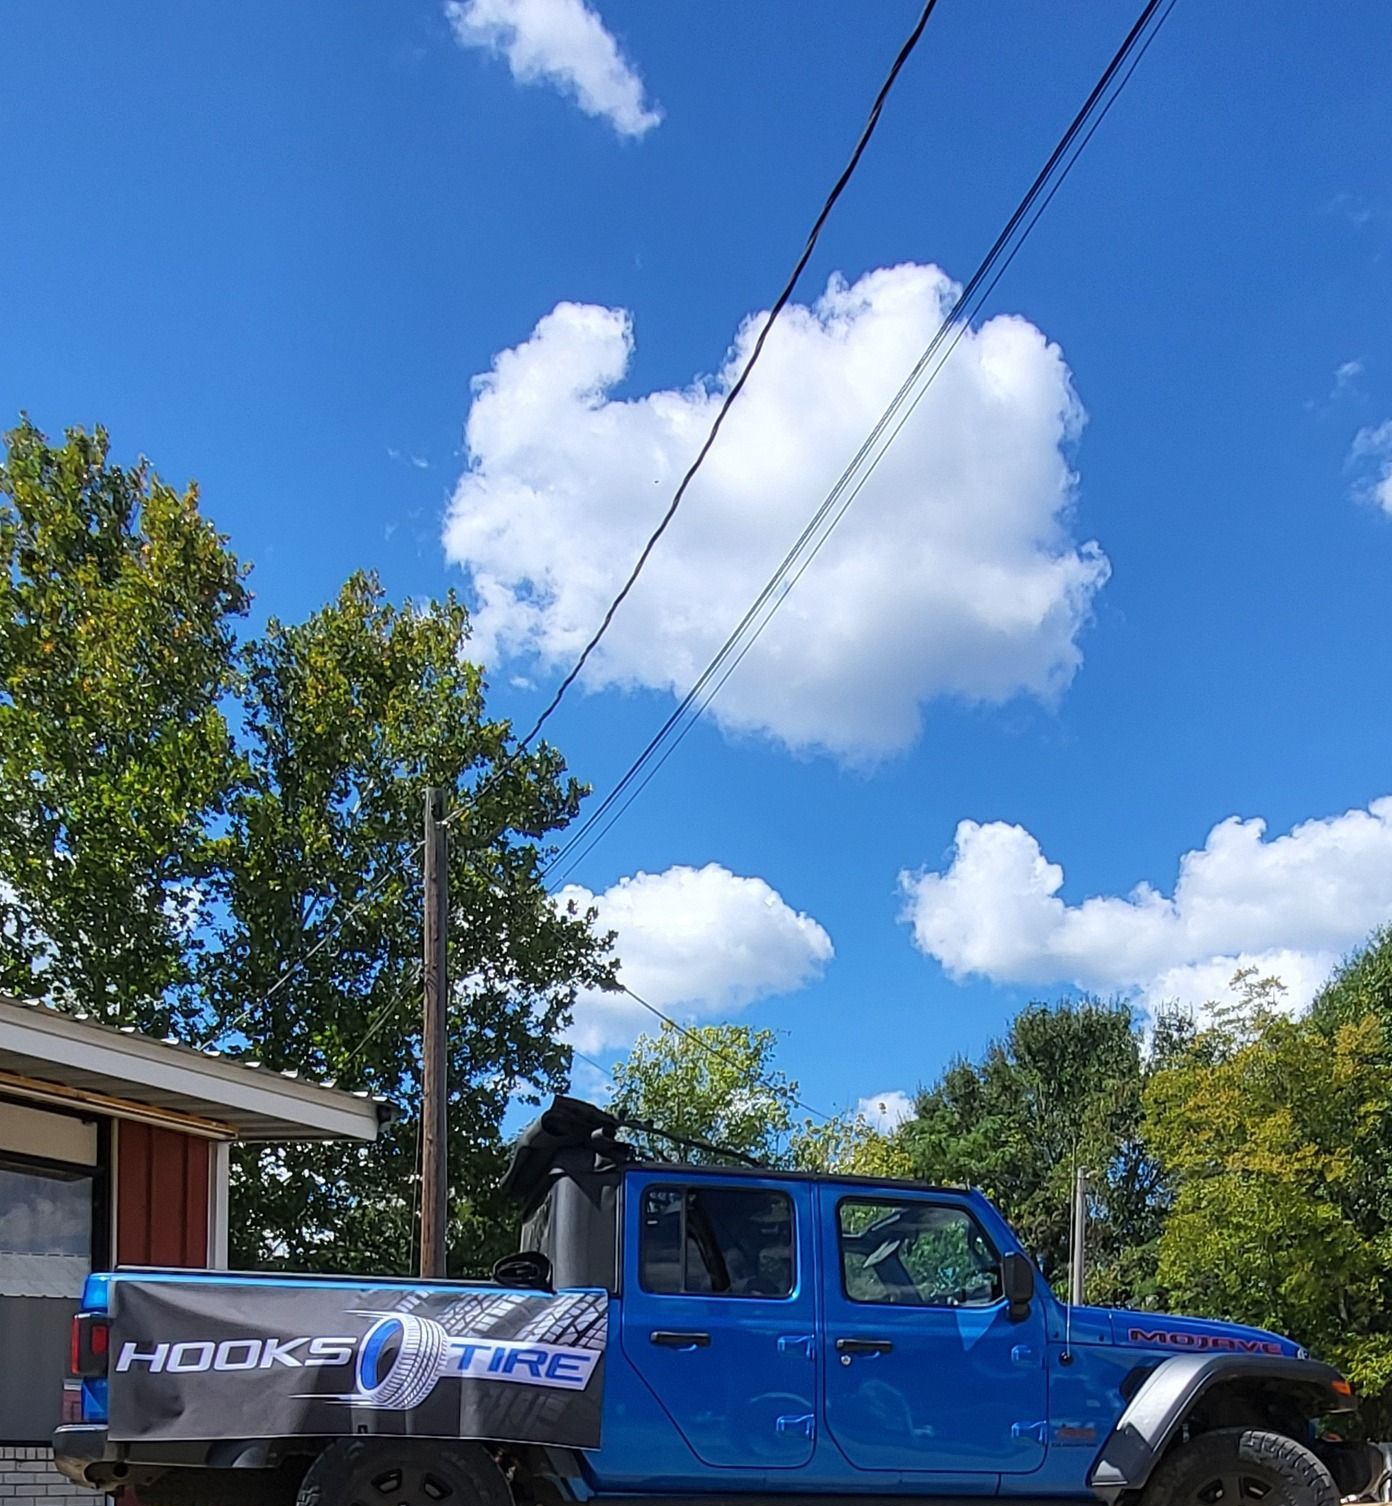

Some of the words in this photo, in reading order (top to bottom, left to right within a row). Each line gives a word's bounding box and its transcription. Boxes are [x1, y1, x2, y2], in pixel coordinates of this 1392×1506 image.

[115, 1336, 358, 1373] HOOKS
[449, 1342, 594, 1382] TIRE
[1128, 1328, 1282, 1355] MOJAVE
